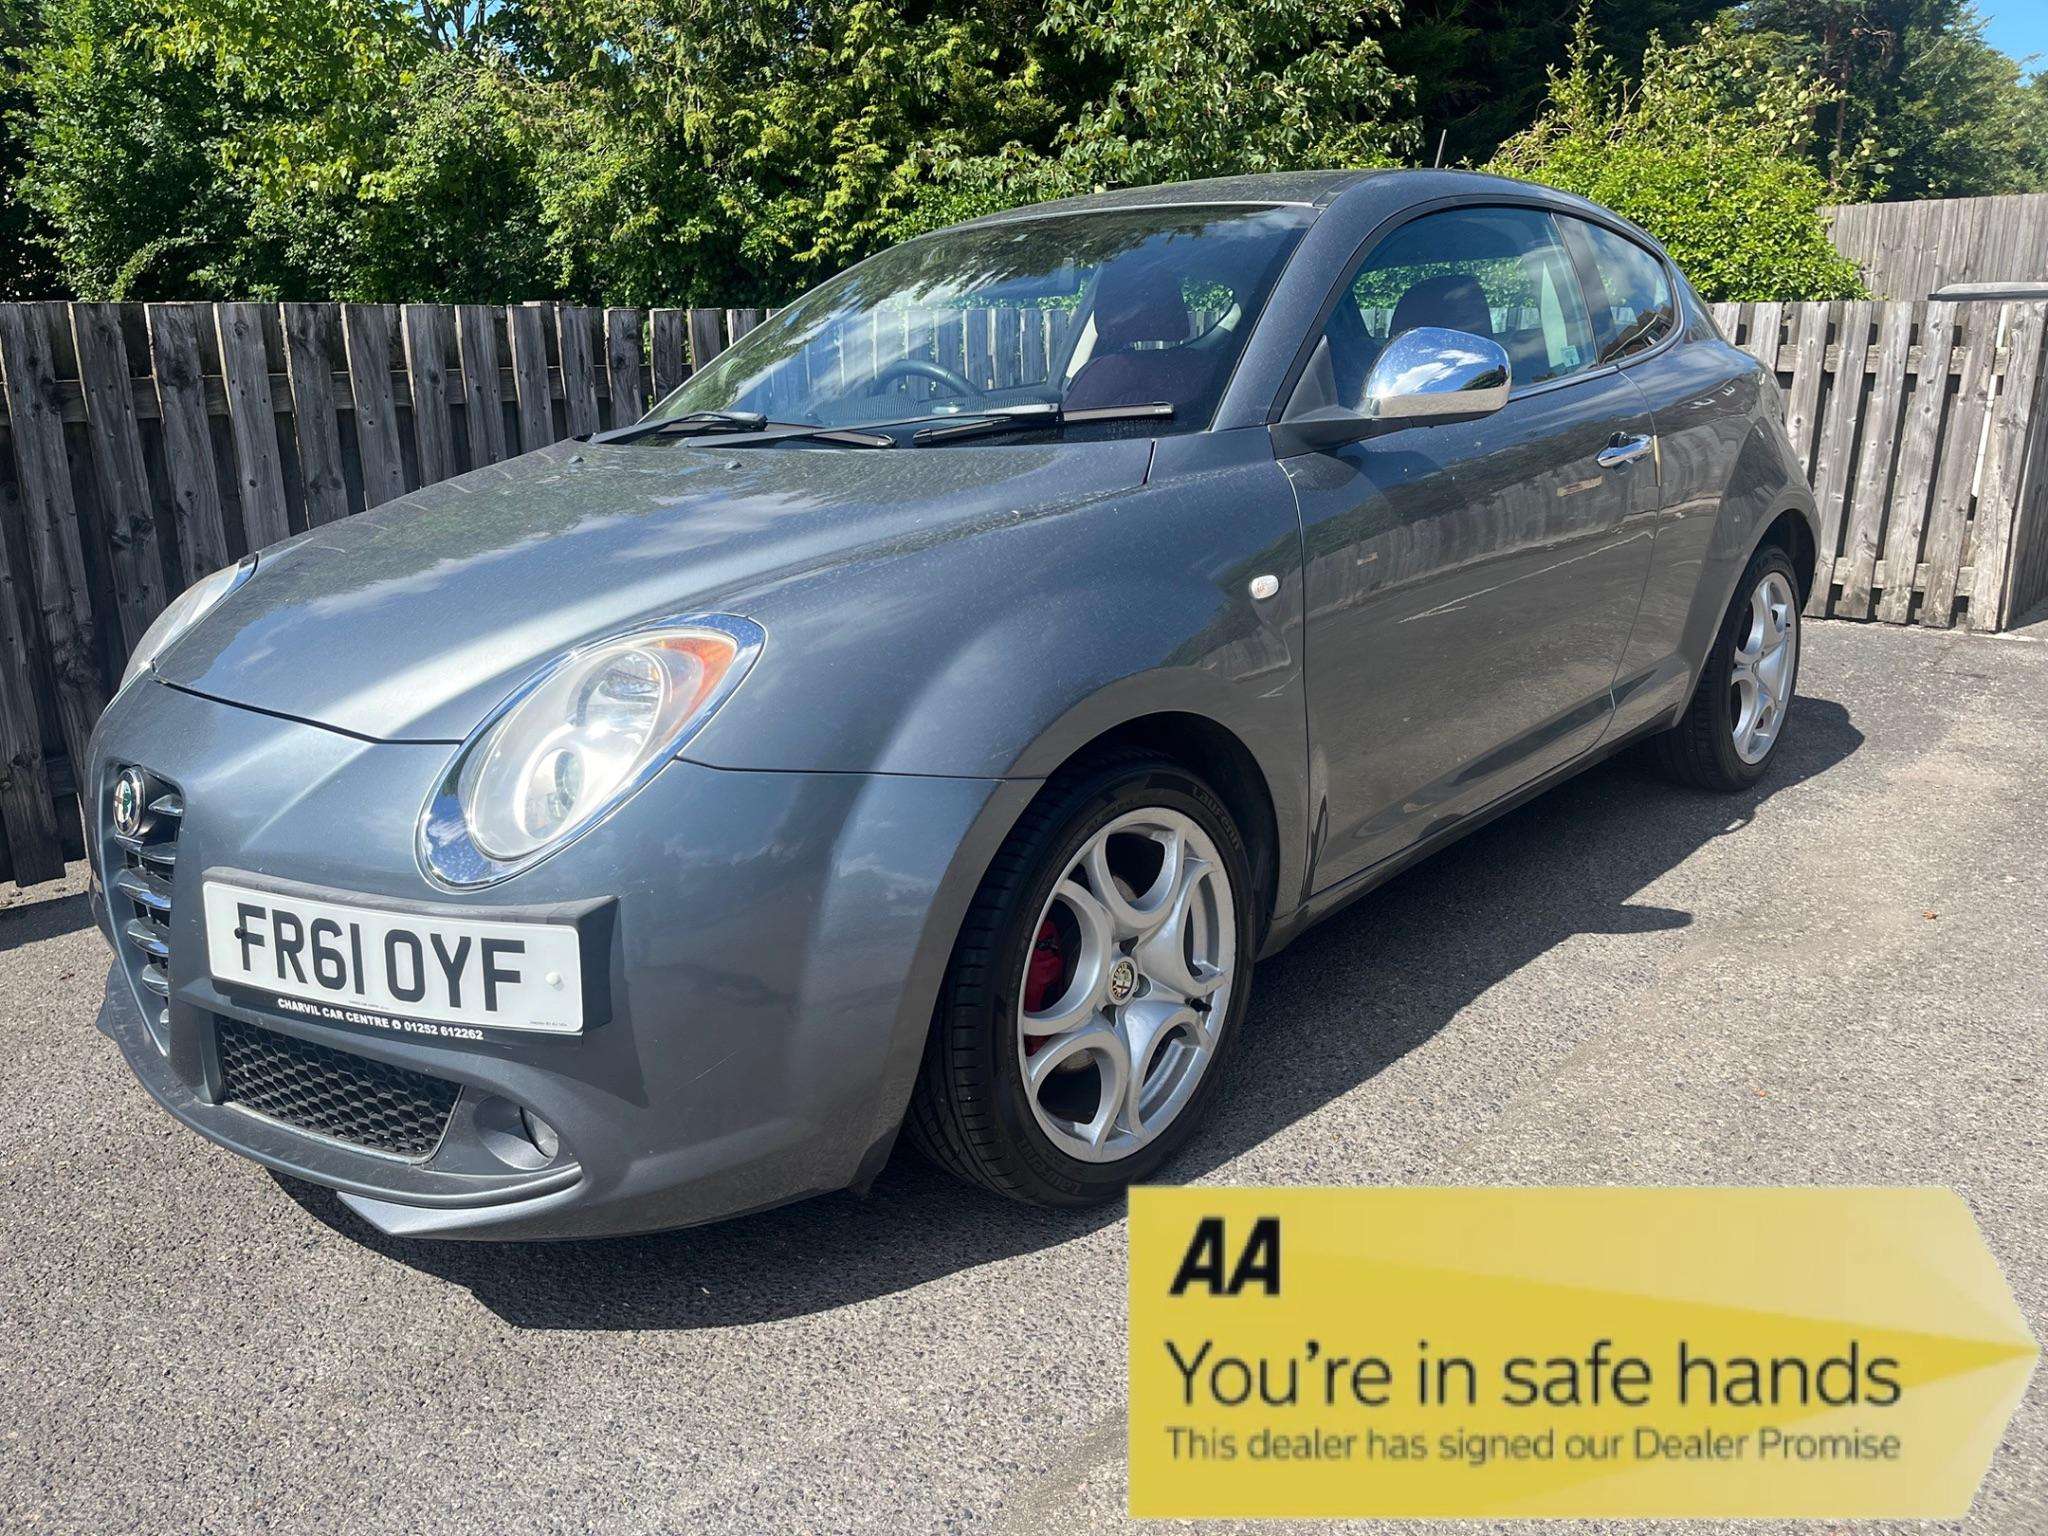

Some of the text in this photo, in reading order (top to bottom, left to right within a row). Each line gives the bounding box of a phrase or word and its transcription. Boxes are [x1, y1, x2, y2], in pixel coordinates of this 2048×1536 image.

[237, 902, 526, 1012] FR61 OYF
[277, 998, 484, 1040] CHARVIL CAR CENTRE 01252 612262
